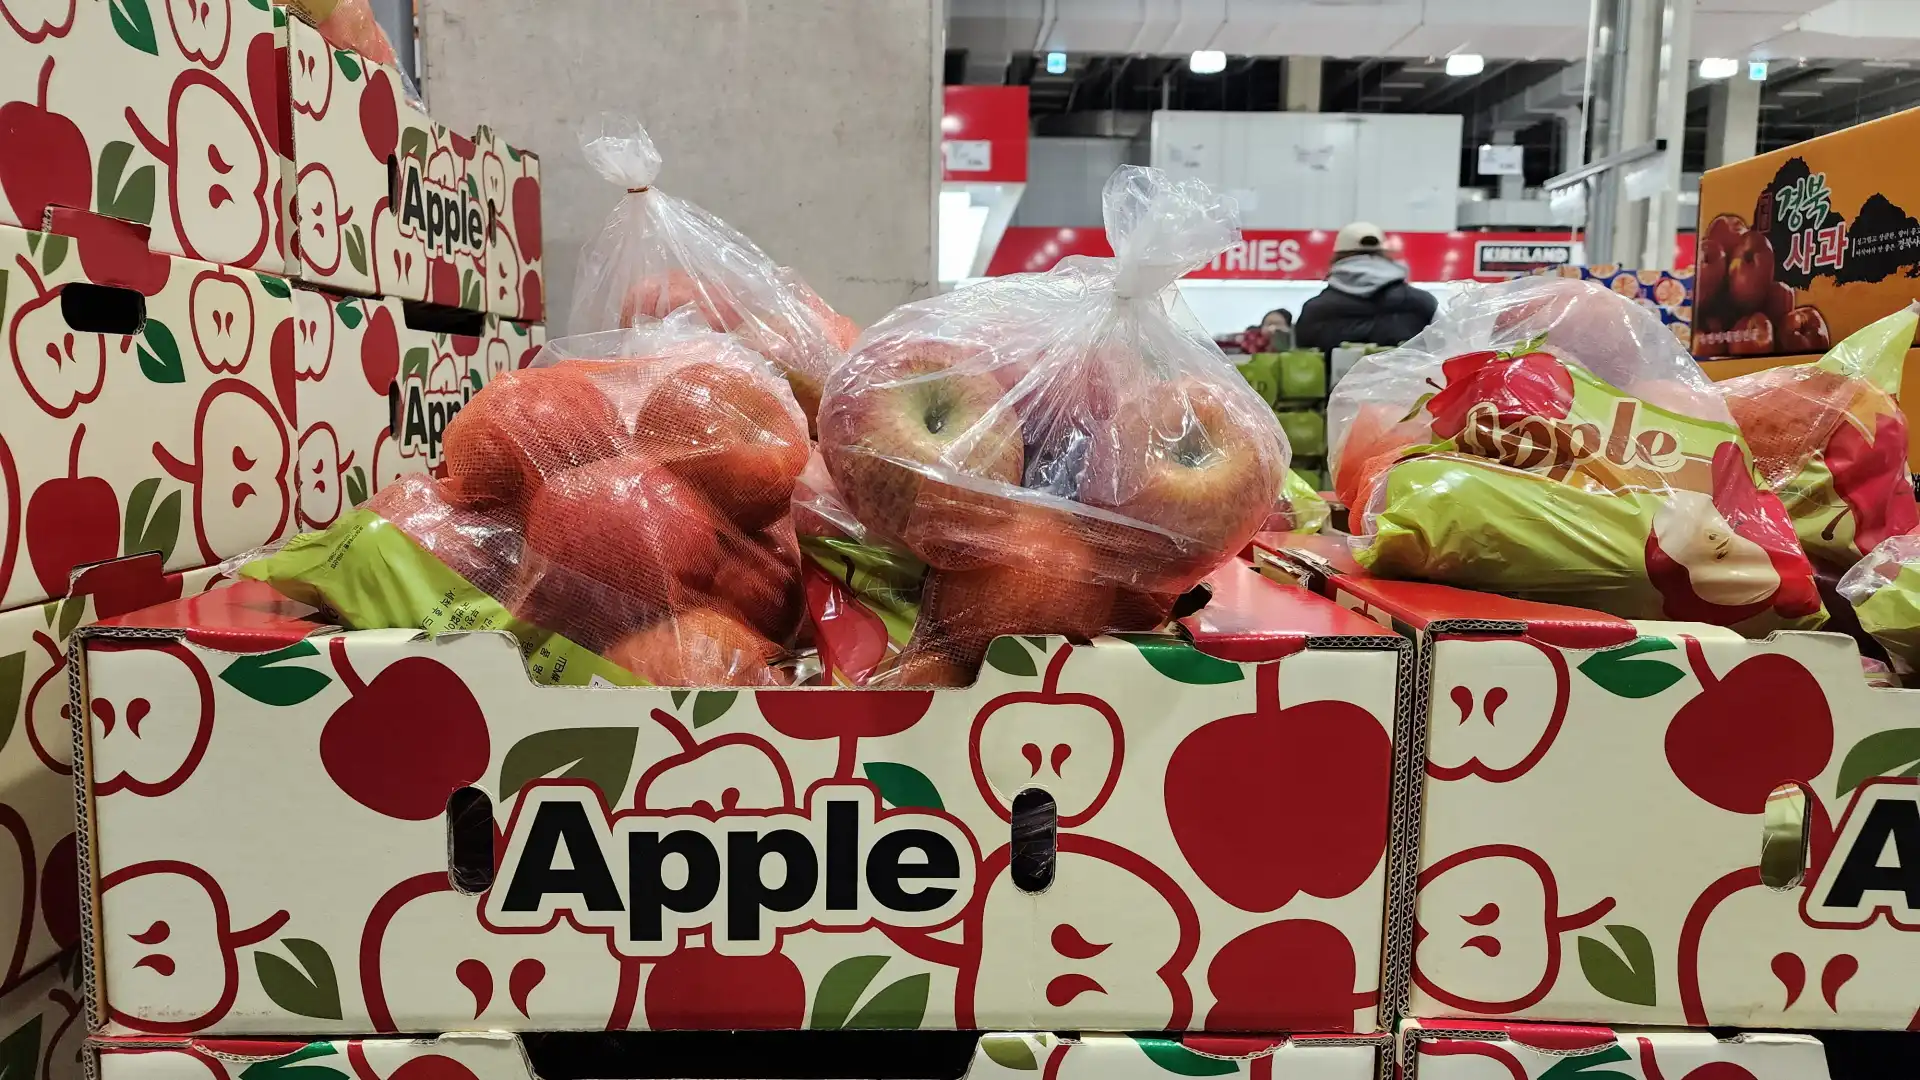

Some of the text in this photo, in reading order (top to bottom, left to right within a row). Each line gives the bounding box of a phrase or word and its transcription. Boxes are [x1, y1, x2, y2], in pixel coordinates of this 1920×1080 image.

[403, 166, 483, 255] Apple
[1776, 172, 1831, 231] 경북
[1783, 222, 1849, 274] 사과
[1897, 236, 1920, 250] 경북사
[1453, 398, 1685, 483] Apple
[432, 607, 443, 616] 후
[439, 590, 455, 608] 세척
[501, 800, 960, 941] Apple
